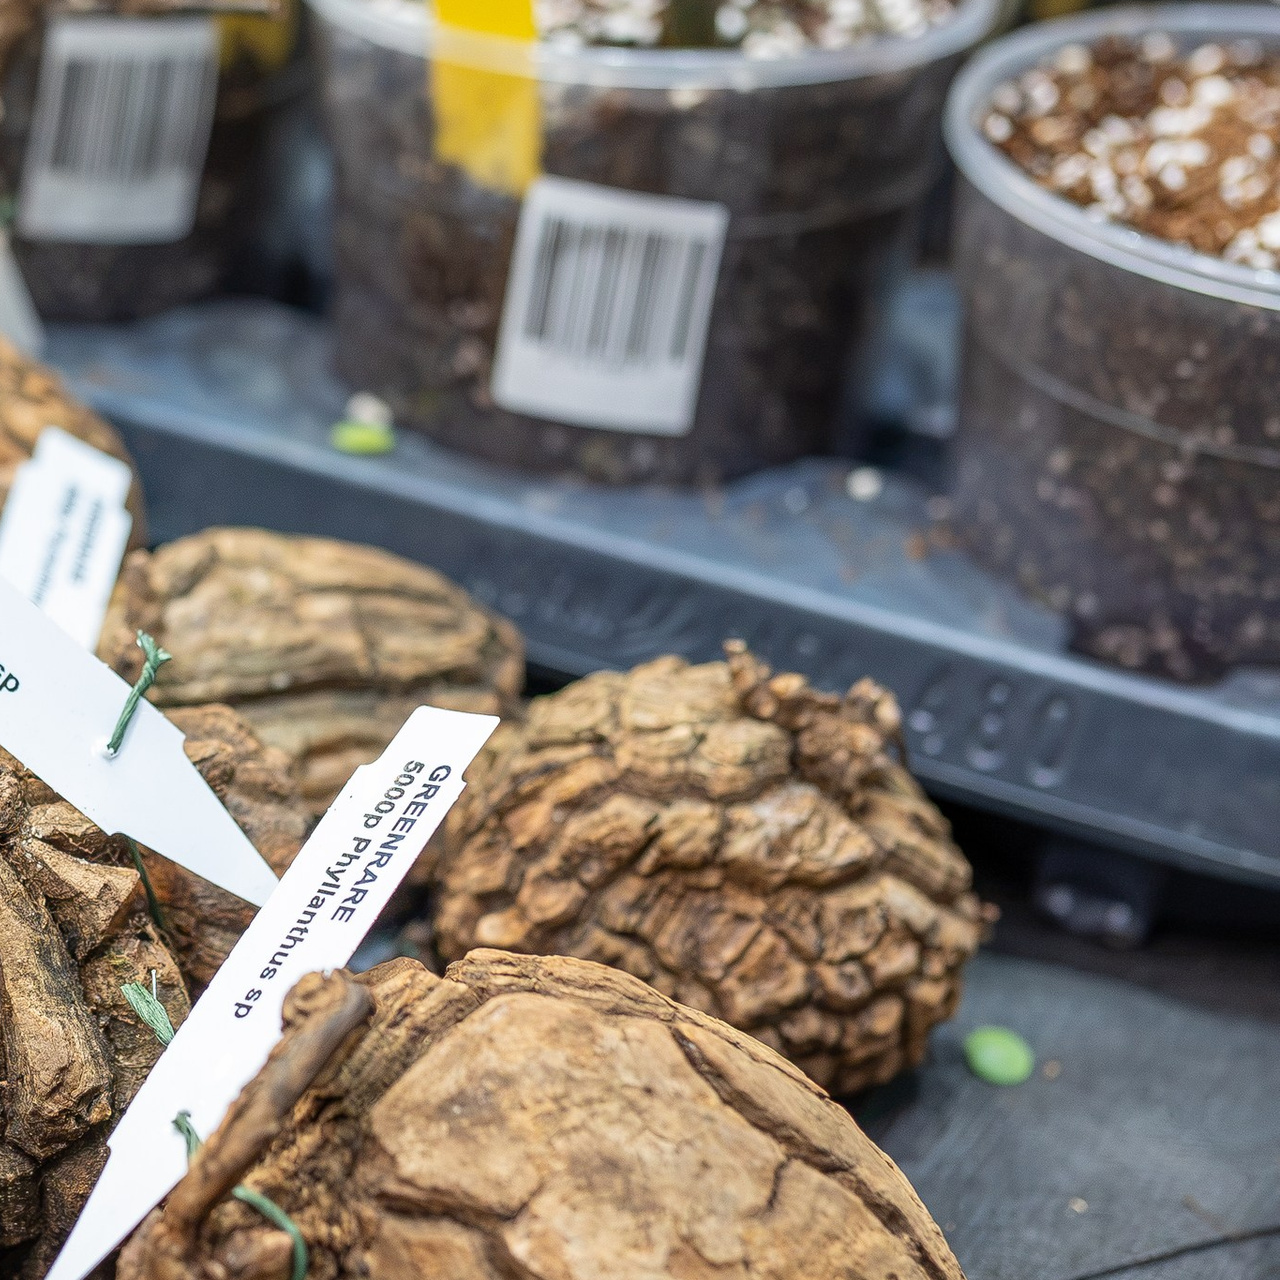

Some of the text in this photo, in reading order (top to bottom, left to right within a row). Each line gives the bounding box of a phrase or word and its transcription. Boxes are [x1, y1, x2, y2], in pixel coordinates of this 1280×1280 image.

[234, 760, 426, 1019] 5000p Phyllanthus sp
[330, 764, 452, 923] GREENRARE
